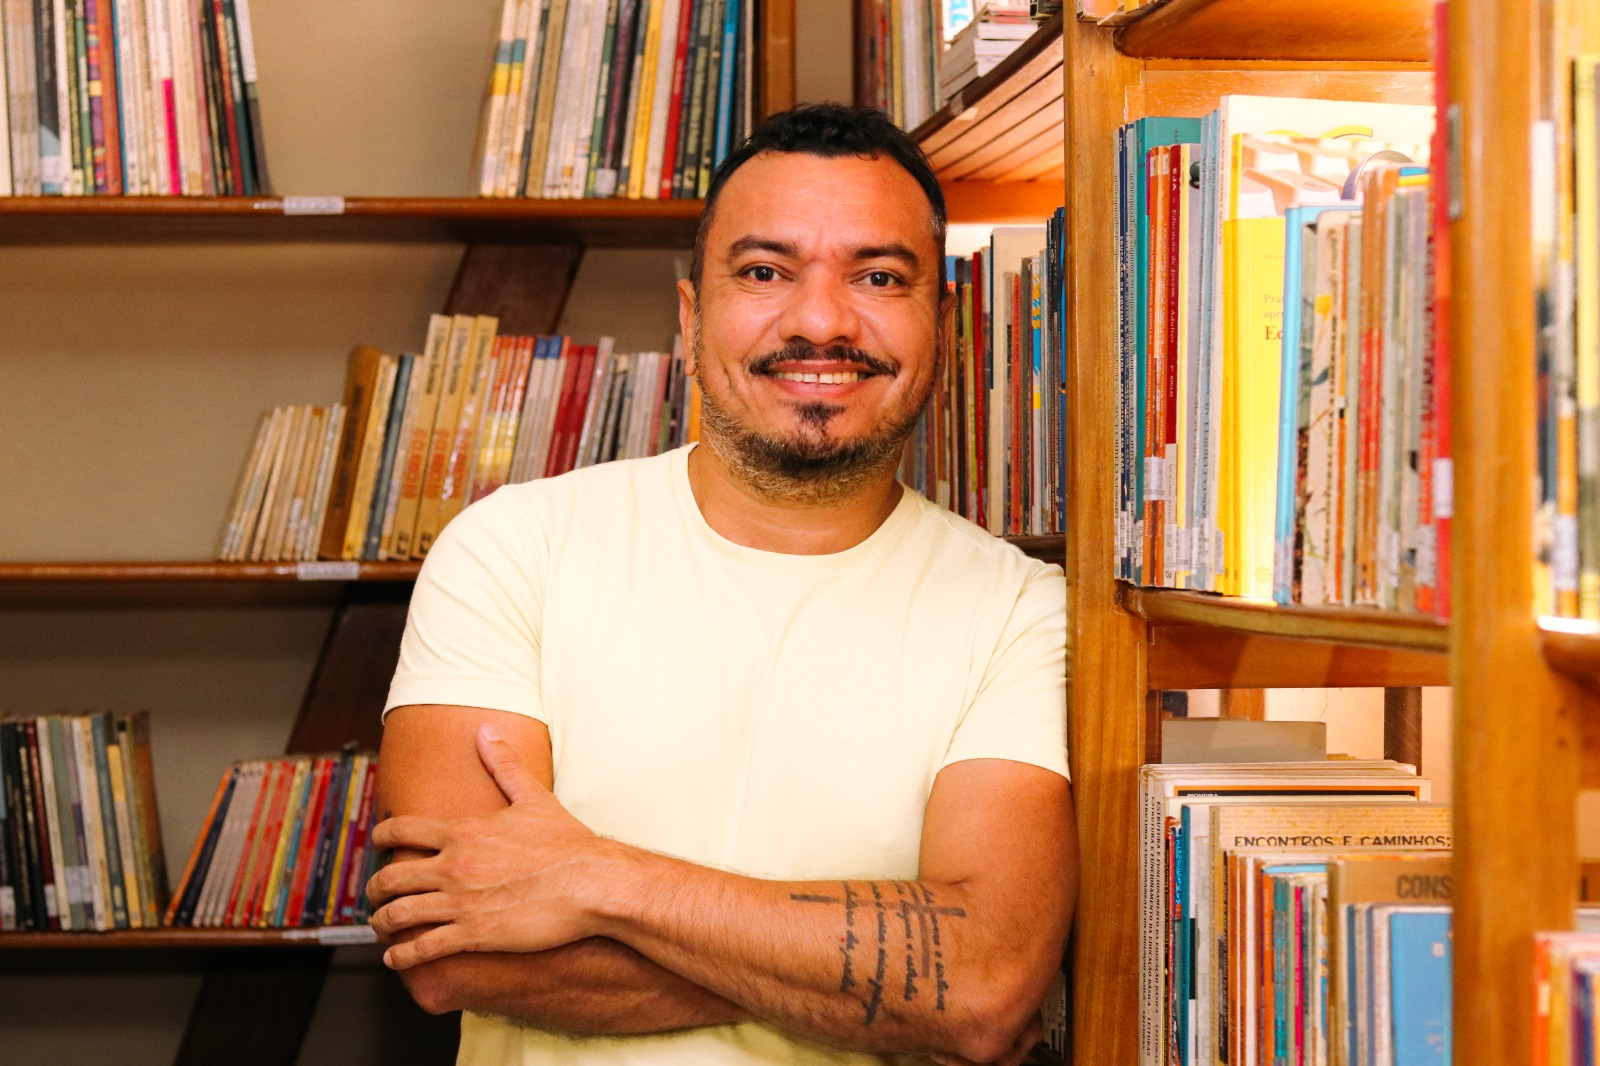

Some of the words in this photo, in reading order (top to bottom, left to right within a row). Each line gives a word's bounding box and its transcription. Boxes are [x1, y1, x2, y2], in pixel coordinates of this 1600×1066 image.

[1171, 255, 1176, 265] de
[1234, 835, 1334, 847] ENCONTROS
[1343, 836, 1353, 846] E
